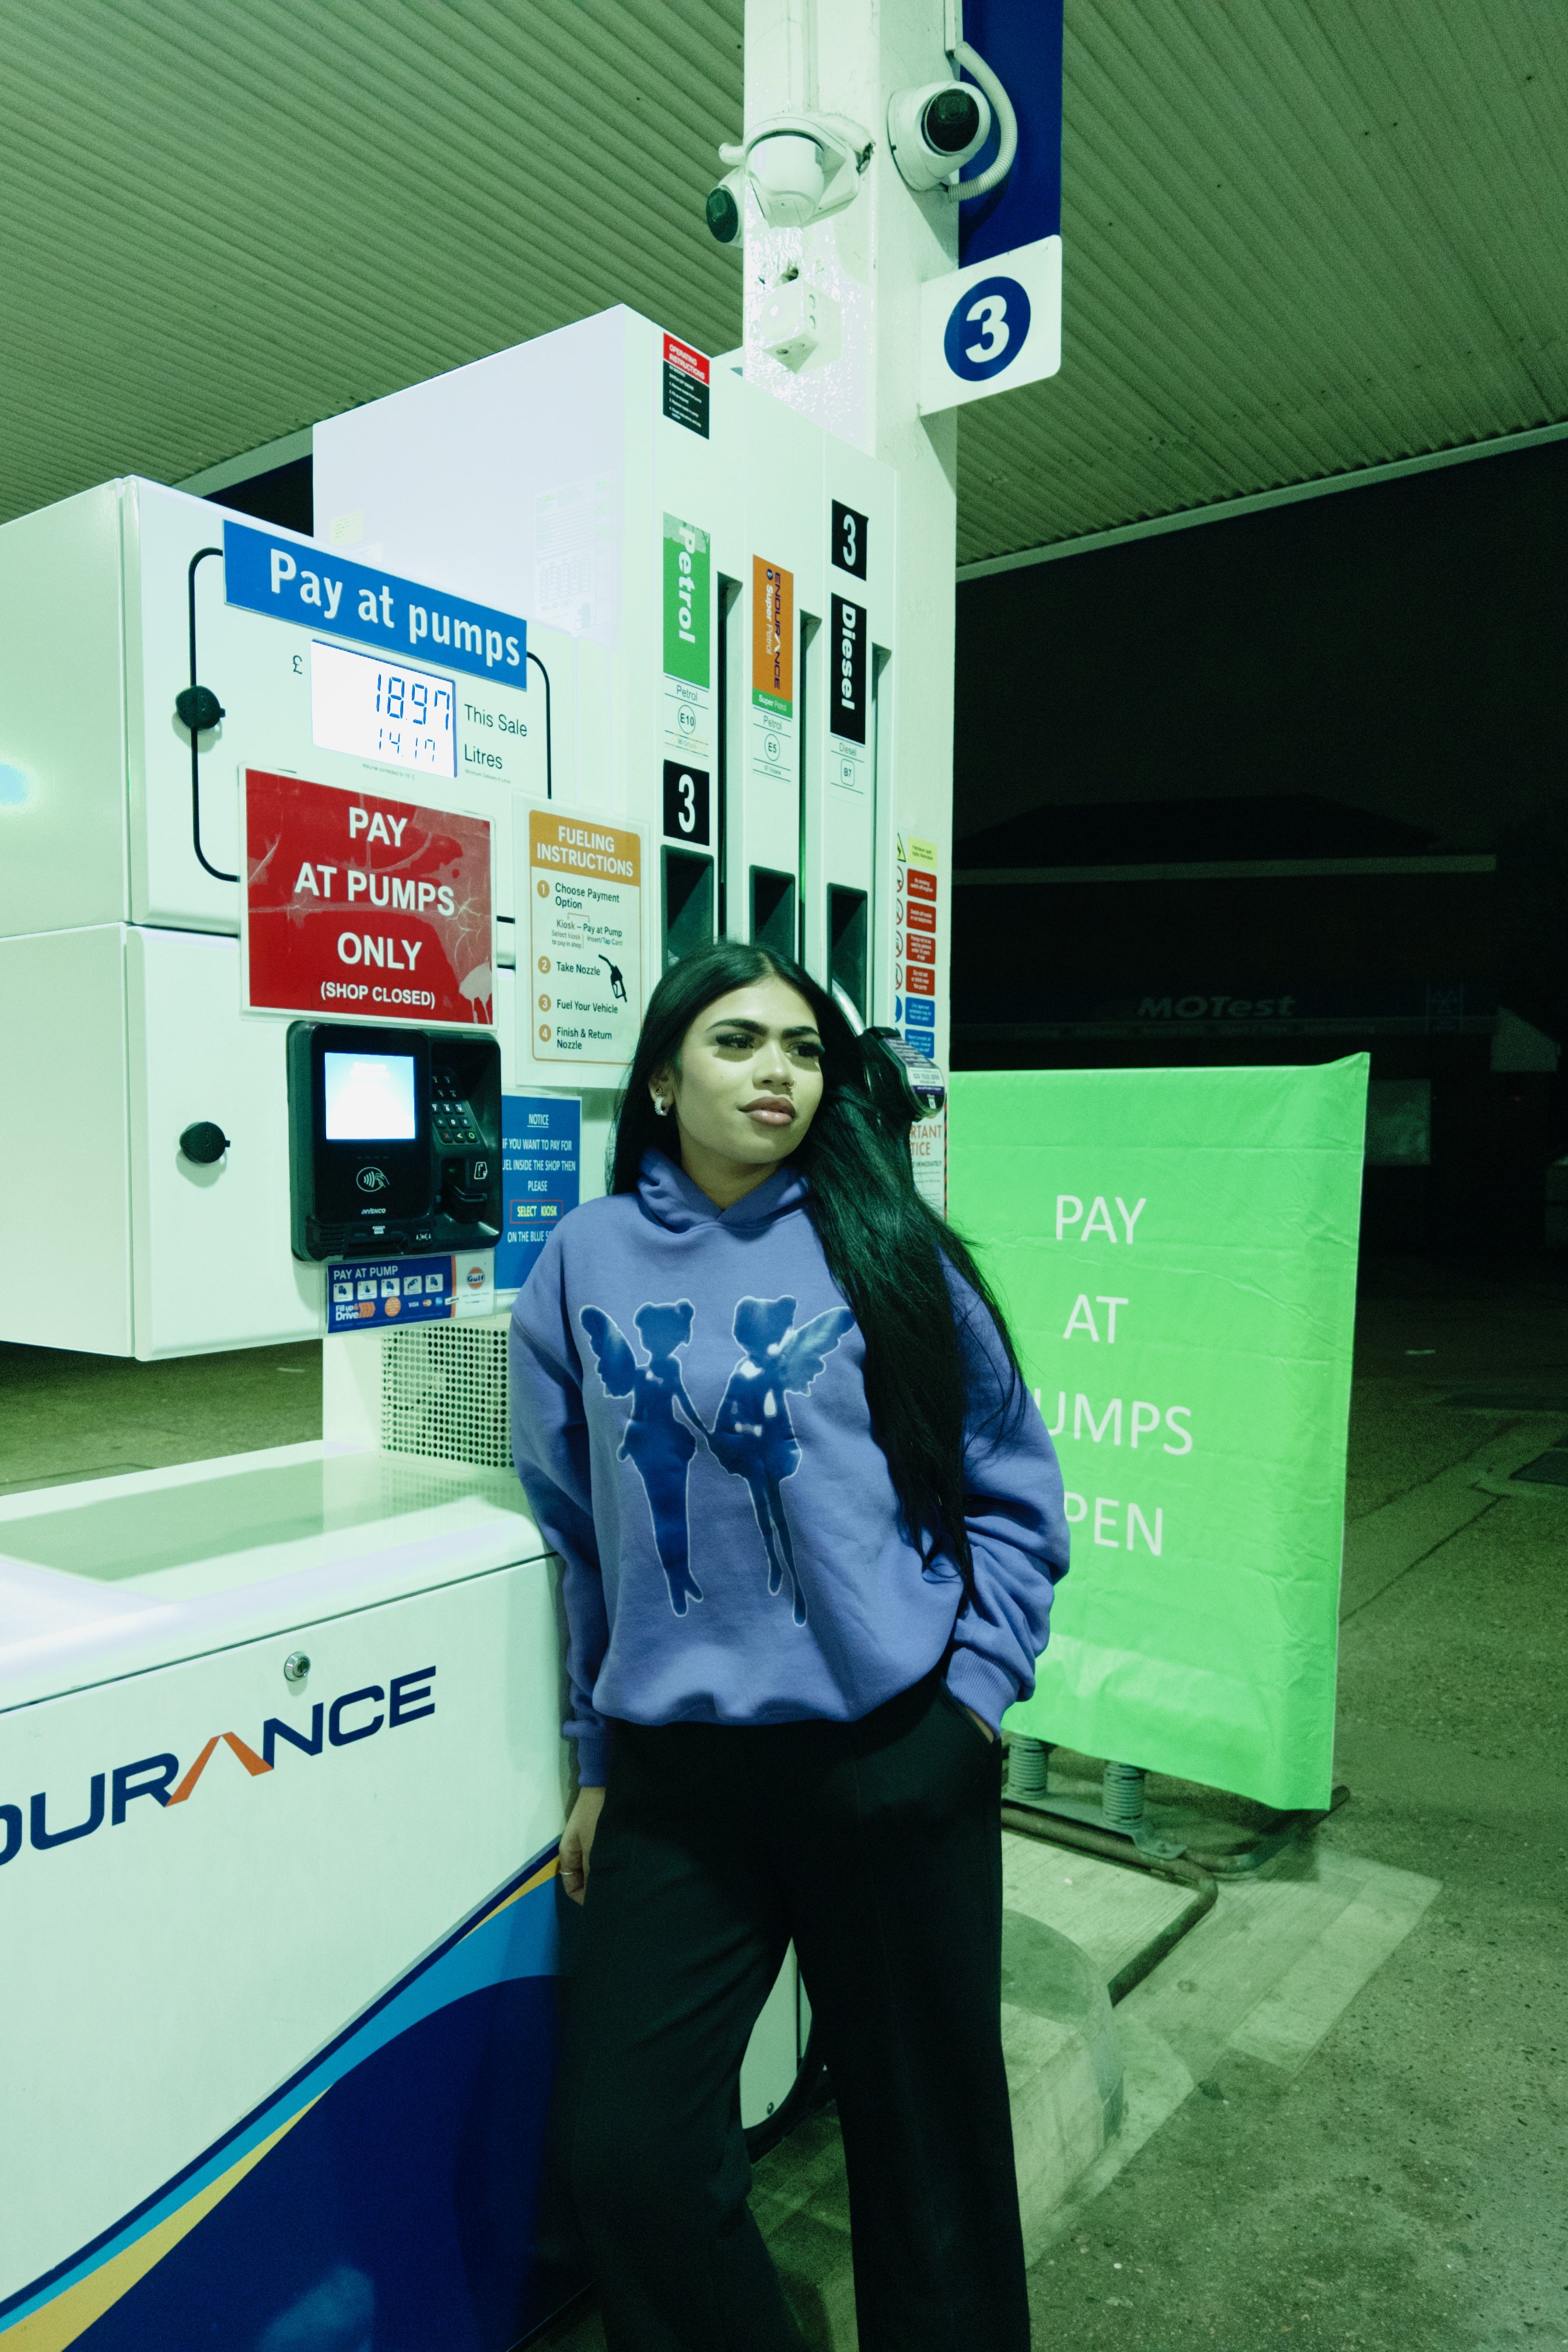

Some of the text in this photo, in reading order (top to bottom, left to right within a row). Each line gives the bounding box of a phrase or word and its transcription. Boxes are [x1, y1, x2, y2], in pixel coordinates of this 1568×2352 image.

[966, 295, 1010, 363] 3
[842, 514, 856, 566] 3
[678, 527, 695, 643] Petrol
[270, 548, 520, 667] Pay at pumps
[765, 584, 774, 622] Super
[292, 655, 303, 674] £
[842, 604, 856, 710] Diesel
[677, 685, 697, 701] Petrol
[759, 694, 774, 706] Super
[464, 704, 527, 737] This Sale
[680, 713, 694, 726] E10
[764, 715, 782, 730] Petrol
[768, 742, 776, 753] E5
[840, 743, 856, 756] Diesel
[464, 744, 502, 769] Litres
[844, 768, 851, 778] B7
[678, 774, 695, 833] 3
[349, 807, 407, 847] PAY
[558, 825, 614, 853] FUELING
[537, 842, 634, 877] INSTRUCTIONS
[294, 862, 455, 916] AT PUMPS
[540, 883, 620, 904] 1 Choose Payment
[555, 897, 582, 909] Option
[556, 919, 575, 929] Kiosk
[583, 923, 594, 934] Pay
[605, 926, 622, 937] Pump
[337, 932, 422, 971] ONLY
[542, 960, 600, 976] 2 Take Nozzle
[321, 982, 435, 1009] (SHOP CLOSED)
[542, 998, 618, 1014] 3 Fuel Your Vehicle
[542, 1027, 611, 1040] 4 Finish & Return
[557, 1040, 582, 1050] Nozzle
[528, 1114, 549, 1125] NOTICE
[911, 1125, 942, 1139] RTANT
[502, 1138, 572, 1151] IF YOU WANT TO PAY FOR
[911, 1142, 930, 1156] TICE
[513, 1160, 532, 1170] INSIDE
[533, 1160, 544, 1171] THE
[545, 1160, 560, 1171] SHOP
[561, 1161, 576, 1171] THEN
[528, 1181, 548, 1192] PLEASE
[517, 1206, 557, 1217] SELECT KIOSK
[1056, 1195, 1146, 1244] PAY
[507, 1231, 517, 1243] ON
[518, 1231, 530, 1242] THE
[530, 1231, 544, 1242] BLUE
[333, 1265, 398, 1280] PAY AT PUMP
[335, 1311, 359, 1321] Drive
[1063, 1294, 1128, 1343] AT
[1034, 1388, 1192, 1455] UMPS
[1064, 1492, 1163, 1556] PEN
